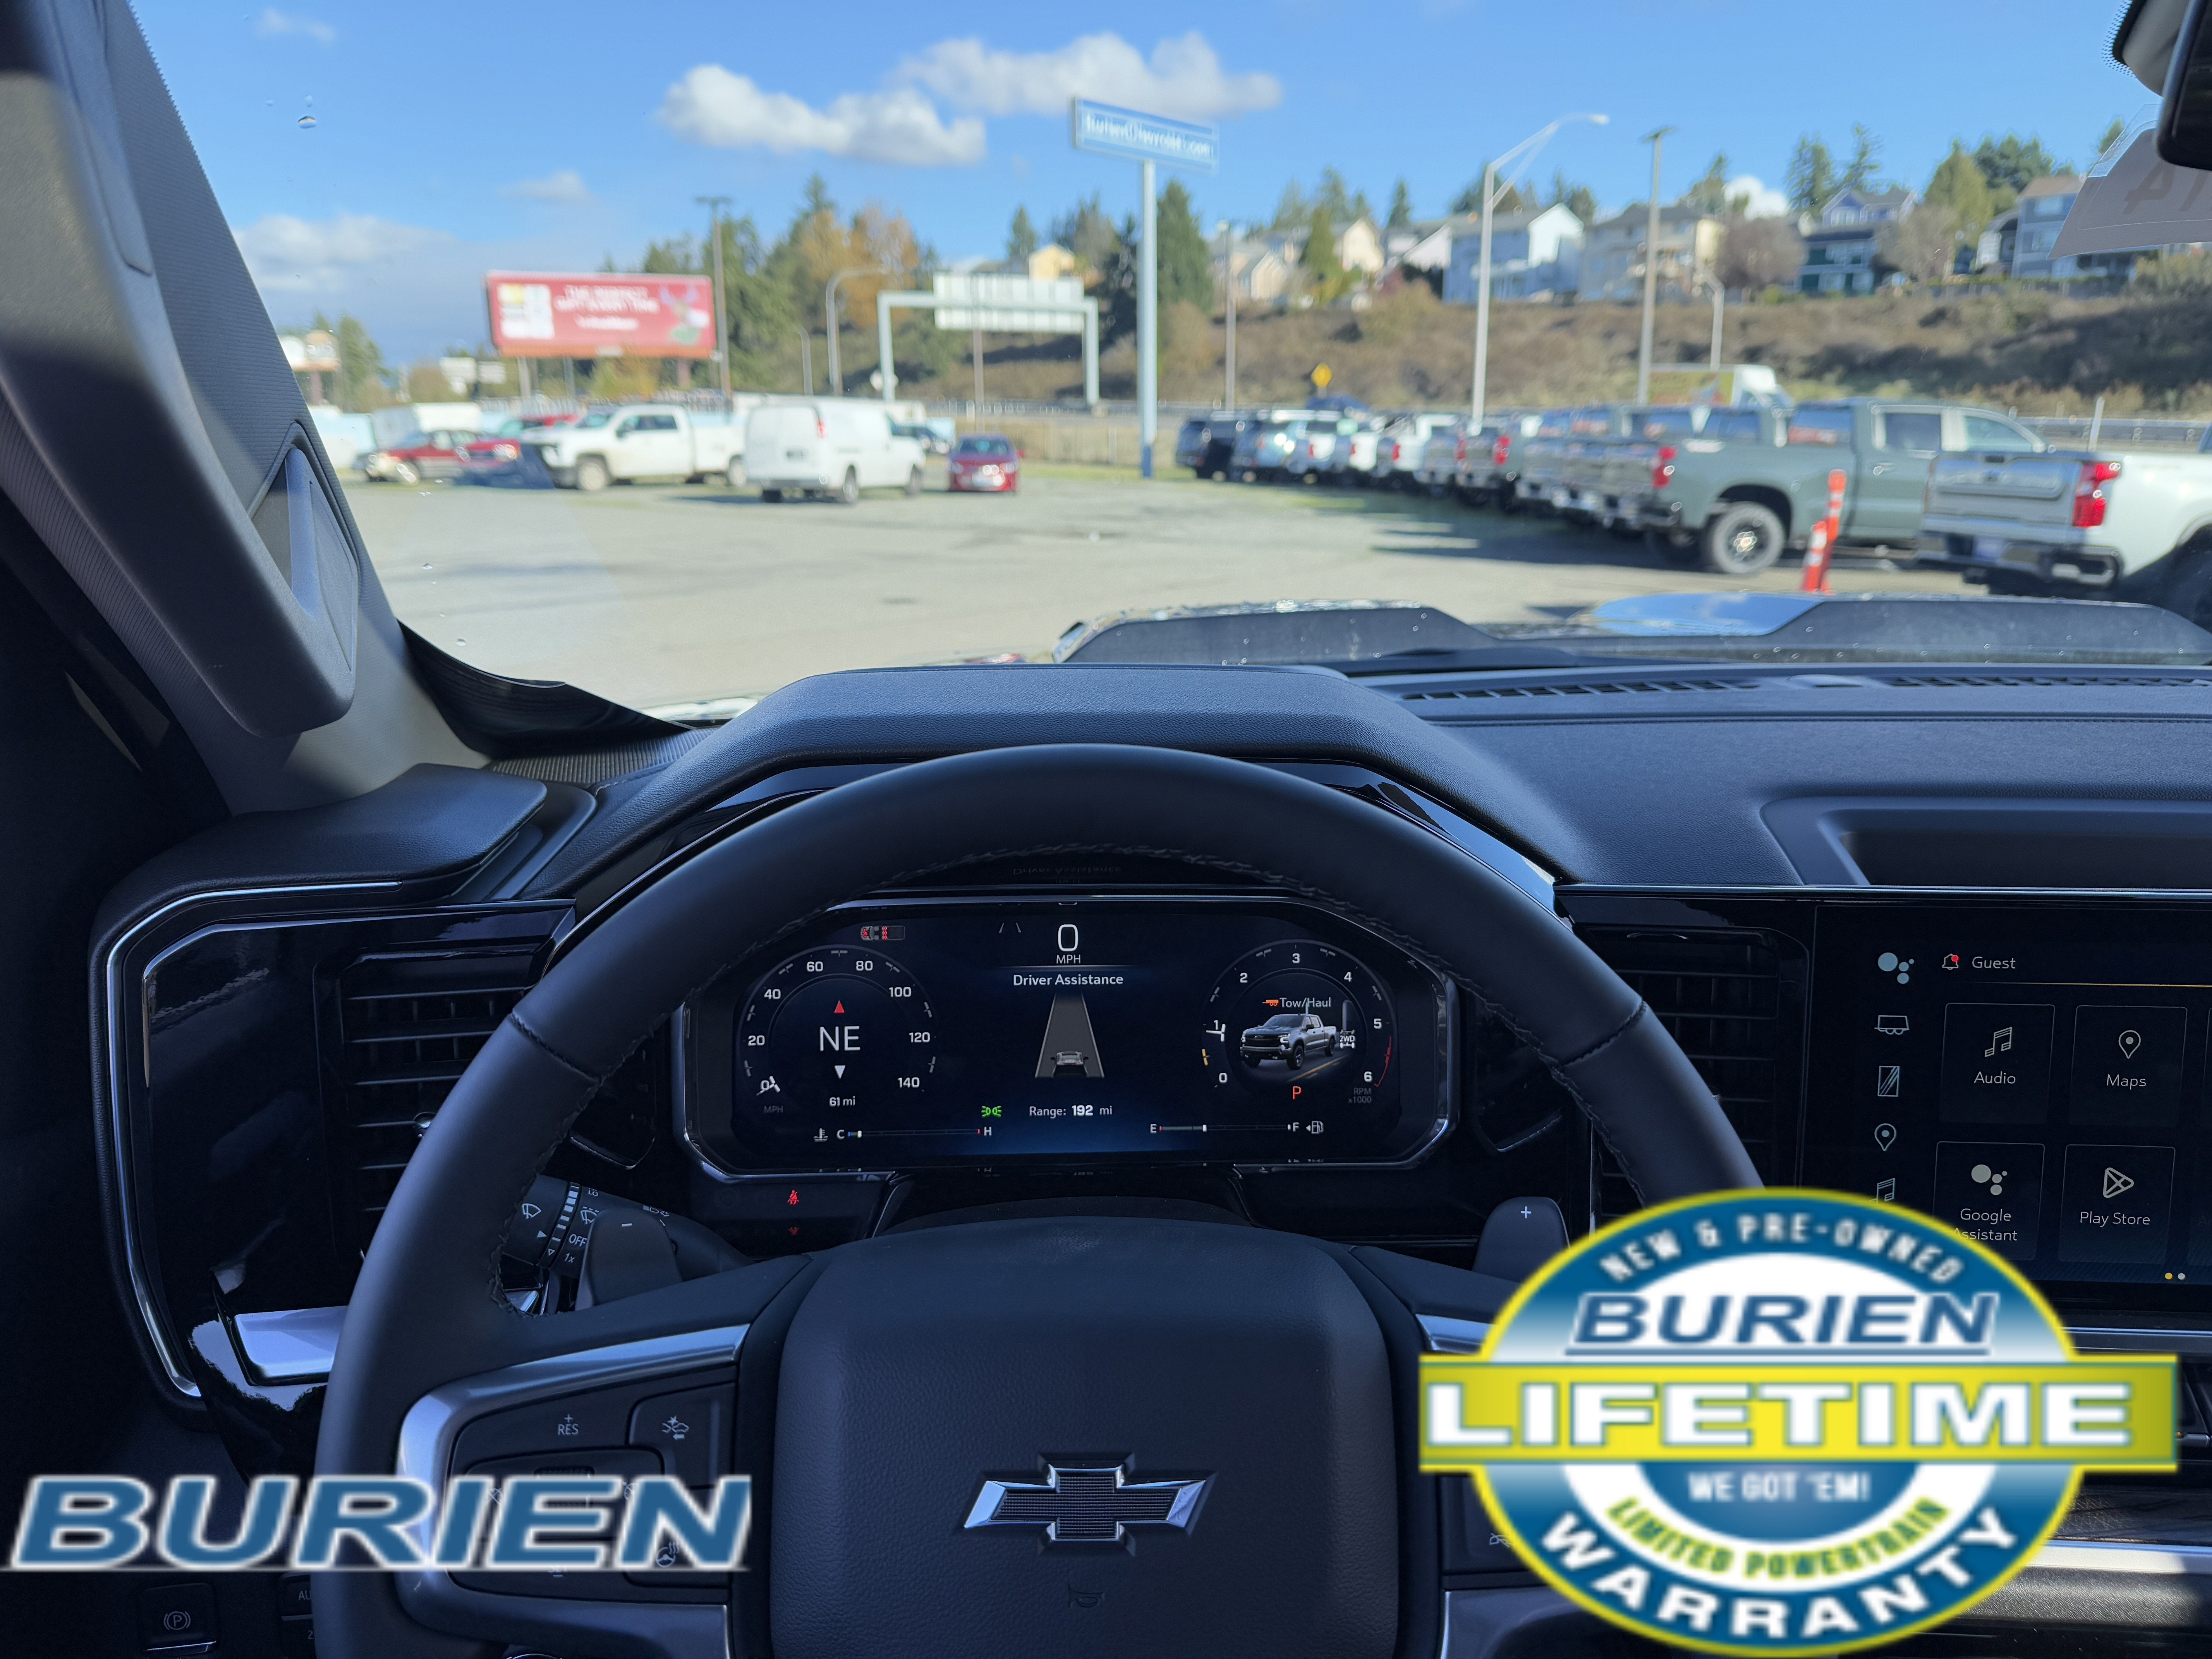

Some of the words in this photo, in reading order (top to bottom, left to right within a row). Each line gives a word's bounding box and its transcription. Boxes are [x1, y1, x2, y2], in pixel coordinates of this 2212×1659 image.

[1058, 924, 1079, 951] 0
[1056, 955, 1081, 964] MPH
[1292, 953, 1300, 963] 3
[1972, 956, 2016, 969] Guest
[807, 961, 823, 972] 60
[856, 960, 873, 971] 80
[1013, 974, 1053, 986] Driver
[1054, 974, 1123, 985] Assistance
[1240, 972, 1248, 983] 2
[1344, 972, 1352, 982] 4
[764, 989, 781, 1000] 40
[889, 986, 912, 997] 100
[1279, 997, 1331, 1008] Tow/Haul
[1213, 1020, 1218, 1030] 1
[1374, 1018, 1382, 1029] 5
[748, 1035, 765, 1046] 20
[820, 1026, 860, 1051] NE
[909, 1032, 930, 1042] 120
[1219, 1072, 1228, 1083] 0
[1364, 1071, 1372, 1082] 6
[1973, 1071, 2016, 1084] Audio
[2106, 1074, 2147, 1090] Maps
[760, 1080, 769, 1091] 0
[898, 1077, 920, 1088] 140
[1292, 1086, 1302, 1099] P
[829, 1097, 840, 1107] 61
[843, 1096, 855, 1106] mi
[1029, 1106, 1066, 1119] Range:
[1072, 1105, 1093, 1116] 192
[1099, 1105, 1112, 1115] mi
[984, 1126, 992, 1136] H
[1150, 1123, 1157, 1133] E
[1293, 1122, 1299, 1132] F
[836, 1129, 845, 1140] C
[1960, 1208, 2011, 1225] Google
[2080, 1211, 2109, 1228] Play
[2112, 1212, 2150, 1225] Store
[1953, 1227, 2018, 1241] Assistant
[568, 1234, 587, 1246] OFF
[564, 1253, 575, 1263] 1x
[558, 1424, 579, 1435] RES
[298, 1590, 312, 1601] AU
